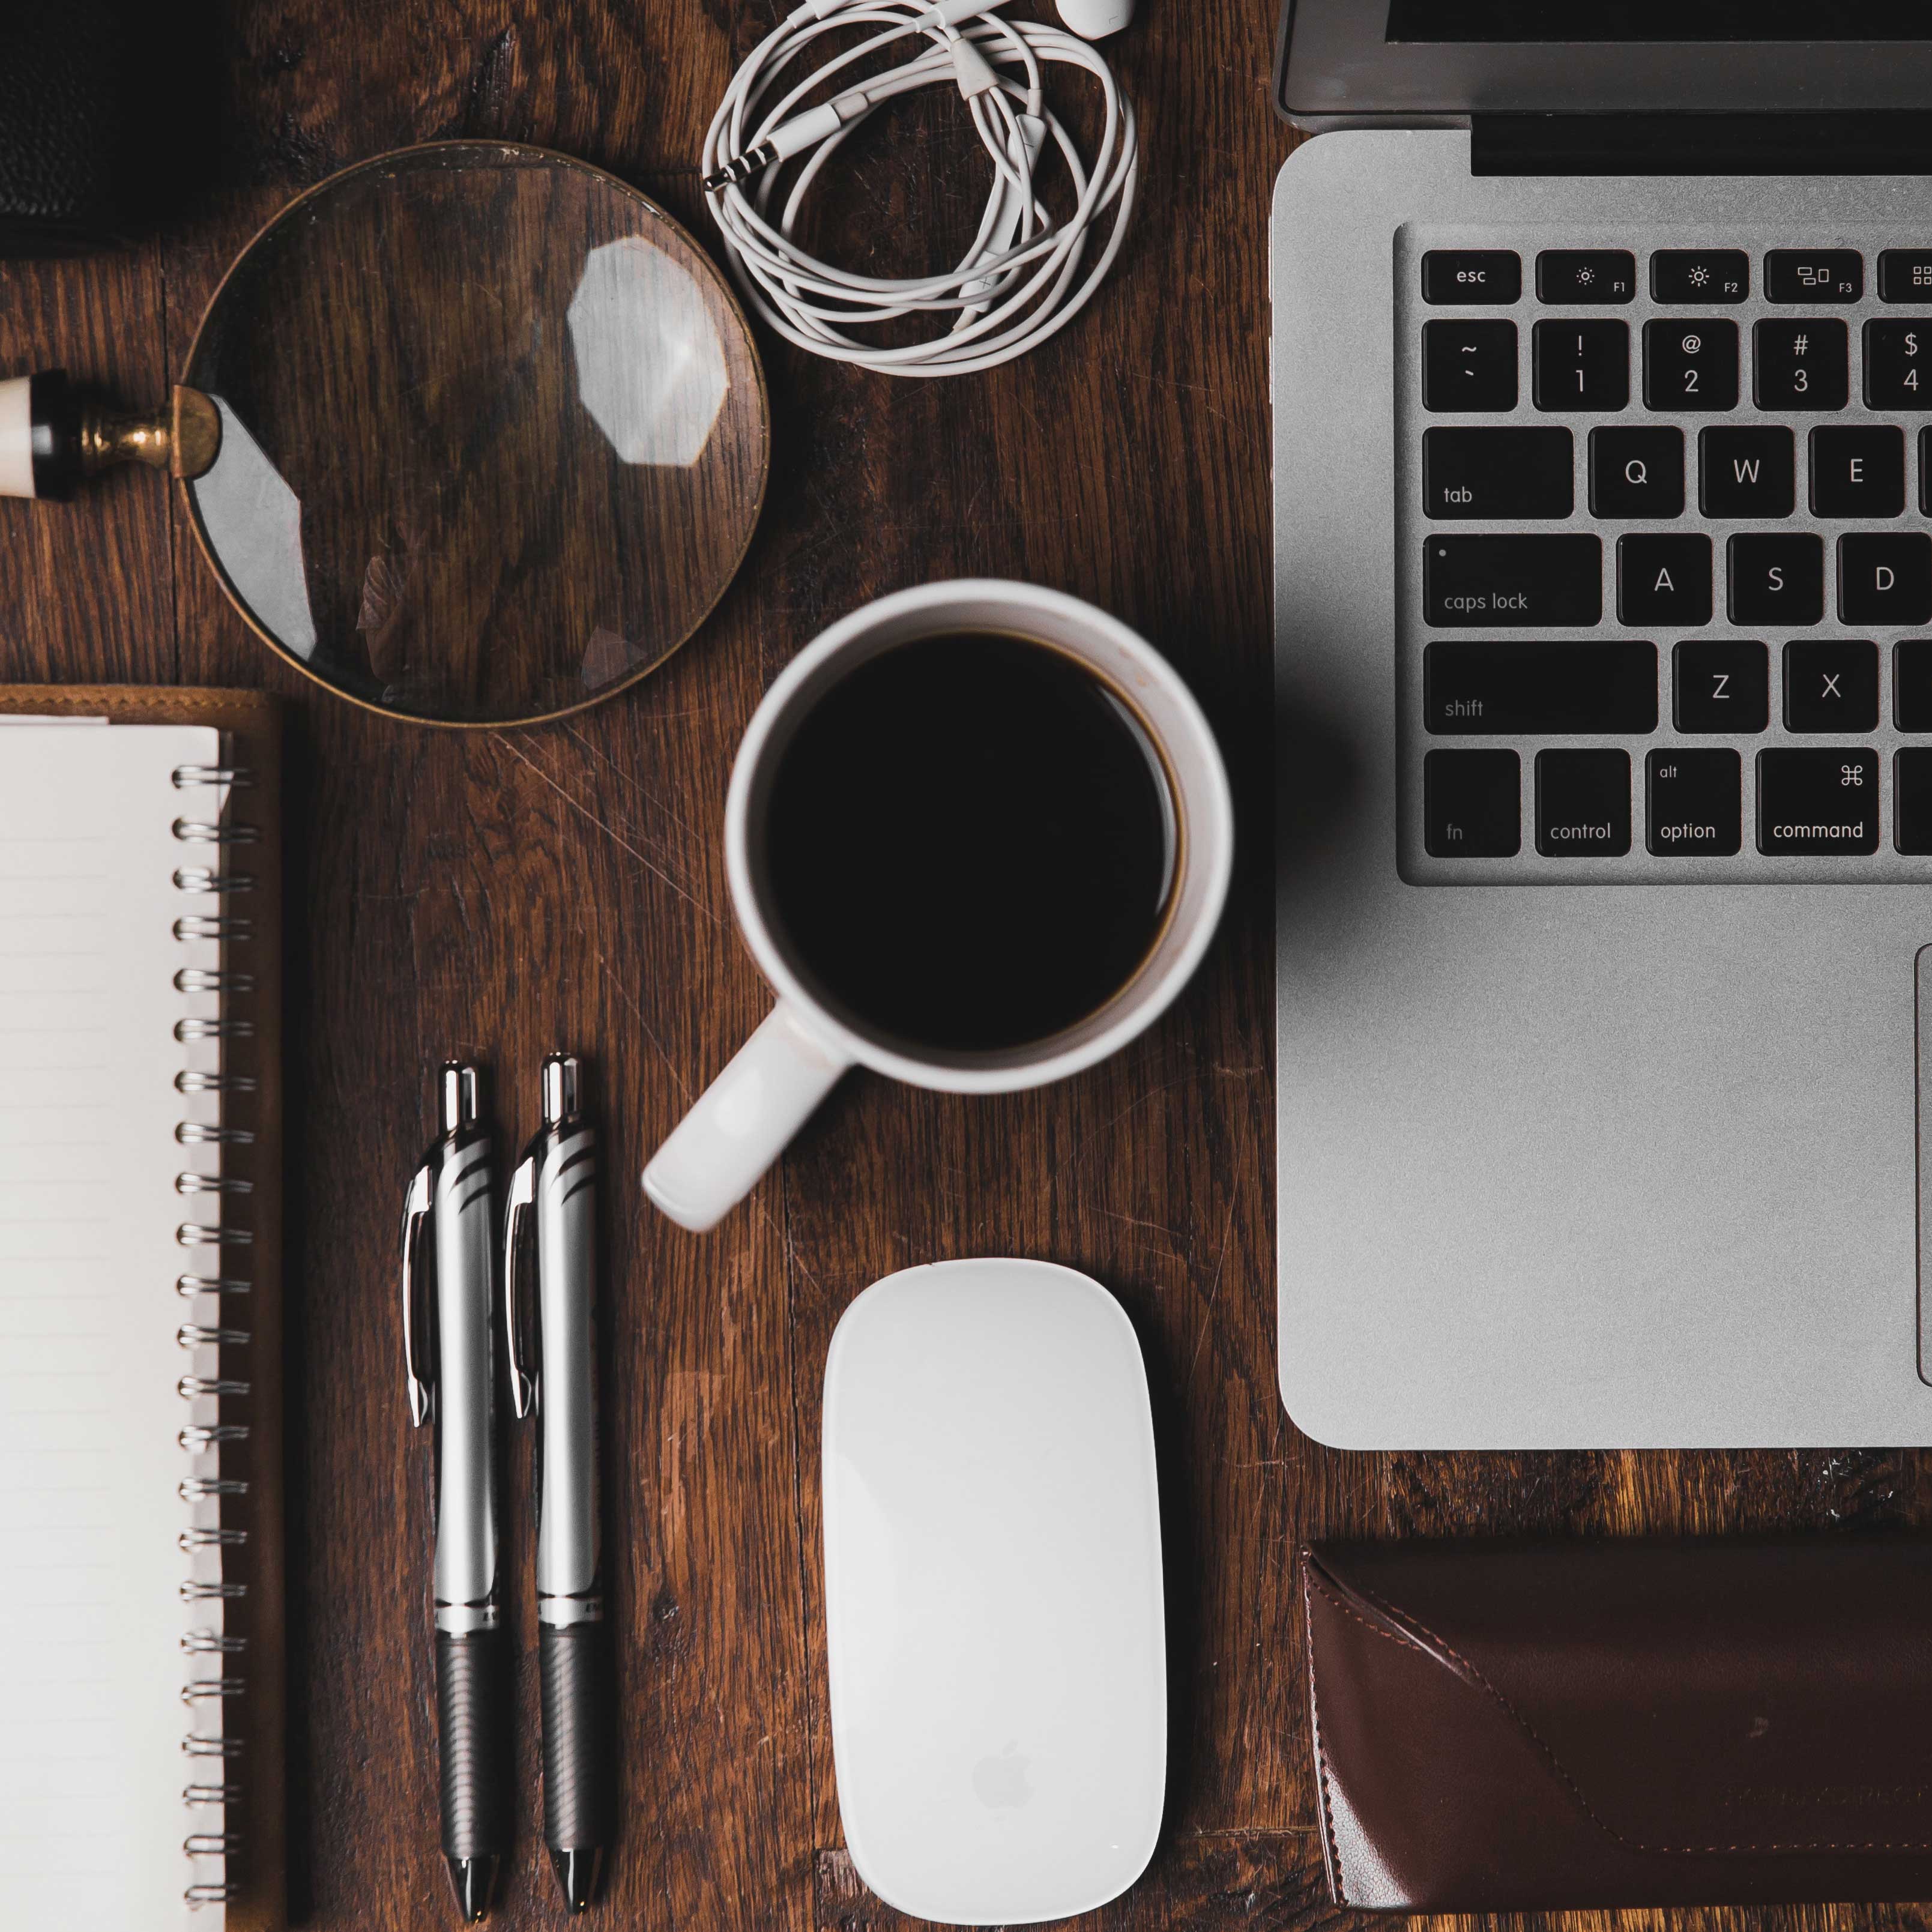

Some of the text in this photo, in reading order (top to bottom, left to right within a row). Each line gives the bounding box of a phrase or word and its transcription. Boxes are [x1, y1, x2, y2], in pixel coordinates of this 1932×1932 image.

[1456, 270, 1487, 283] esc
[1613, 281, 1625, 293] F1
[1724, 282, 1739, 293] F2
[1838, 282, 1853, 294] F3
[1578, 334, 1583, 357] !
[1681, 334, 1702, 355] @
[1793, 334, 1810, 356] #
[1904, 331, 1918, 357] $
[1575, 369, 1584, 393] 1
[1683, 369, 1700, 393] 2
[1793, 368, 1808, 393] 3
[1903, 368, 1919, 391] 4
[1625, 459, 1648, 485] Q
[1733, 459, 1760, 484] W
[1850, 457, 1864, 483] E
[1443, 485, 1473, 503] tab
[1653, 567, 1675, 592] A
[1767, 566, 1784, 592] S
[1876, 566, 1895, 591] D
[1444, 591, 1529, 614] caps lock
[1712, 674, 1730, 699] Z
[1821, 673, 1842, 698] X
[1444, 699, 1484, 717] shift
[1659, 764, 1677, 779] alt
[1446, 823, 1463, 841] fn
[1550, 821, 1611, 840] control
[1660, 822, 1716, 843] option
[1773, 820, 1864, 839] command
